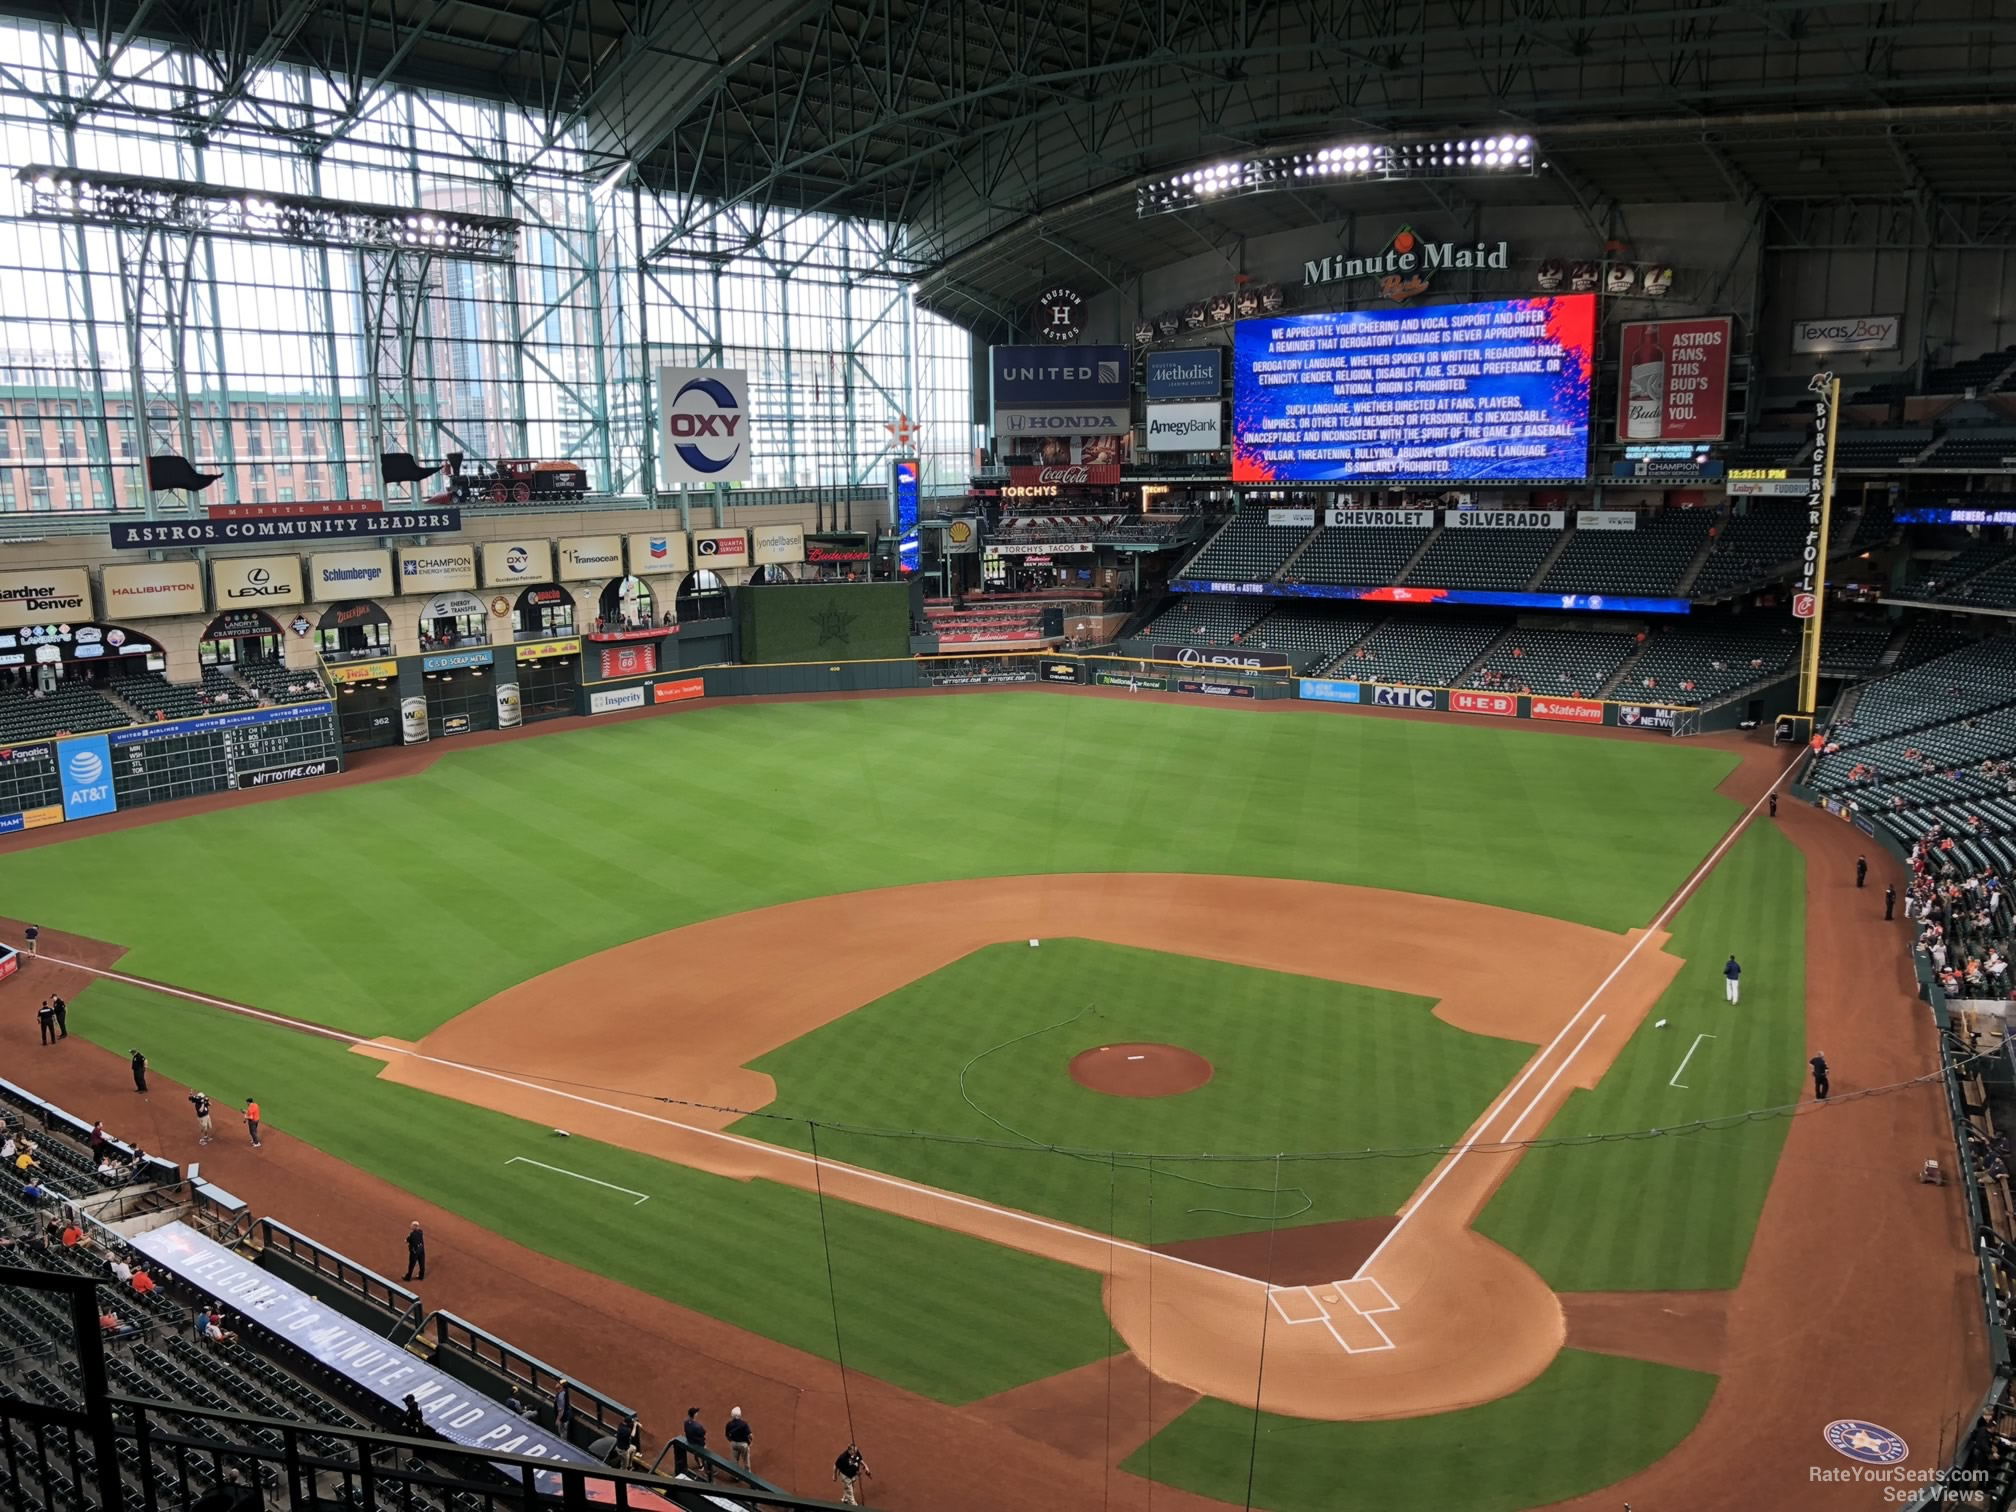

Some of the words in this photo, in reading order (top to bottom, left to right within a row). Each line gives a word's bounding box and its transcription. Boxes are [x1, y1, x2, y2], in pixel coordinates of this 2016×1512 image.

[1304, 250, 1415, 286] Minute
[1423, 242, 1508, 269] Maid
[1041, 289, 1081, 305] HOUSTON
[1052, 307, 1070, 324] H
[1272, 328, 1284, 339] WE
[1286, 325, 1333, 338] APPRECIATE
[1336, 323, 1357, 335] YOUR
[1359, 320, 1399, 334] CHEERING
[1401, 319, 1419, 330] AND
[1421, 317, 1449, 329] VOCAL
[1452, 314, 1490, 327] SUPPORT
[1494, 312, 1512, 324] AND
[1515, 310, 1544, 323] OFFER
[1801, 323, 1848, 340] Texas
[1855, 321, 1892, 341] Bay
[1043, 327, 1079, 340] ASTROS
[1672, 332, 1722, 346] ASTROS
[1276, 340, 1315, 352] REMINDER
[1318, 338, 1337, 350] THAT
[1340, 335, 1393, 348] DEROGATORY
[1396, 332, 1440, 345] LANGUAGE
[1453, 329, 1482, 342] NEVER
[1253, 360, 1302, 372] DEROGATORY
[1351, 354, 1389, 367] WHETHER
[1392, 352, 1424, 364] SPOKEN
[1427, 351, 1438, 363] OR
[1485, 346, 1535, 360] REGARDING
[1672, 348, 1706, 362] FANS,
[1003, 368, 1092, 380] UNITED
[1153, 365, 1213, 381] Methodist
[1447, 364, 1480, 376] SEXUAL
[1547, 359, 1560, 372] OR
[1672, 363, 1699, 376] THIS
[1334, 384, 1373, 396] NATIONAL
[1375, 382, 1402, 394] ORIGIN
[1415, 379, 1467, 392] PROHIBITED.
[1670, 377, 1708, 390] BUD'S
[1670, 393, 1694, 405] FOR
[1286, 405, 1305, 416] SUCH
[1354, 401, 1392, 412] WHETHER
[1395, 400, 1435, 412] DIRECTED
[1438, 399, 1448, 410] AT
[1479, 396, 1522, 408] PLAYERS,
[1312, 417, 1338, 428] OTHER
[1340, 416, 1361, 427] TEAM
[1364, 414, 1404, 426] MEMBERS
[1420, 412, 1472, 424] PERSONNEL,
[1485, 410, 1549, 423] INEXCUSABLE,
[1669, 407, 1696, 420] YOU.
[671, 414, 741, 437] OXY
[1029, 416, 1117, 428] HONDA
[1150, 419, 1216, 436] AmegyBank
[1244, 431, 1301, 443] UNACCEPTABLE
[1304, 431, 1320, 442] AND
[1322, 430, 1377, 441] INCONSISTENT
[1380, 428, 1401, 440] WITH
[1404, 428, 1419, 439] THE
[1422, 428, 1449, 439] SPIRIT
[1464, 426, 1481, 437] THE
[1483, 426, 1508, 436] GAME
[1525, 424, 1574, 436] BASEBALL.
[1397, 447, 1433, 458] ABUSIVE
[1449, 446, 1496, 457] OFFENSIVE
[1498, 444, 1547, 457] LANGUAGE
[1355, 462, 1397, 473] SIMILARLY
[1039, 466, 1091, 484] Coca-Cola
[1728, 470, 1766, 479] 12:37:11
[1768, 470, 1786, 478] PM
[1001, 486, 1057, 497] TORCHYS
[229, 506, 305, 515] MINUTE
[322, 504, 366, 512] MAID
[1951, 510, 1985, 522] BREWERS
[1335, 512, 1423, 525] CHEVROLET
[1458, 513, 1551, 527] SILVERADO
[127, 525, 214, 543] ASTROS
[226, 518, 358, 537] COMMUNITY
[368, 514, 450, 530] LEADERS
[757, 535, 802, 548] lyondellbasell
[720, 545, 744, 553] SERVICES
[807, 548, 870, 561] Budweiser
[418, 557, 471, 568] CHAMPION
[507, 555, 528, 564] OXY
[573, 554, 618, 564] Transocean
[1803, 531, 1818, 591] FOUL
[322, 566, 382, 582] Schlumberger
[444, 566, 471, 574] SERVICES
[112, 583, 195, 596] HALLIBURTON
[228, 584, 291, 598] LEXUS
[1211, 582, 1236, 592] BREWERS
[1242, 583, 1263, 593] ASTROS
[27, 598, 83, 610] Denver
[214, 629, 250, 637] CRAWFORD
[970, 633, 1008, 641] Budweiser
[450, 657, 468, 665] SCRAP
[622, 658, 633, 667] 66
[1202, 655, 1260, 667] LEXUS
[499, 696, 518, 705] WM
[605, 693, 641, 706] Insperity
[1374, 687, 1433, 708] RTIC
[298, 706, 325, 714] AIRLINES
[405, 711, 425, 719] WM
[374, 717, 389, 725] 362
[150, 726, 179, 734] AIRLINES
[12, 747, 48, 759] Fanatics
[224, 734, 235, 785] AMERICAN
[253, 763, 325, 785] NITTOTIRE.COM
[71, 786, 108, 805] AT&T
[181, 1250, 288, 1310] WELCOME
[277, 1305, 320, 1331] TO
[309, 1326, 415, 1386] MINUTE
[402, 1380, 485, 1428] MAID
[1830, 1422, 1857, 1448] HOUSTON
[1879, 1437, 1902, 1461] ASTROS
